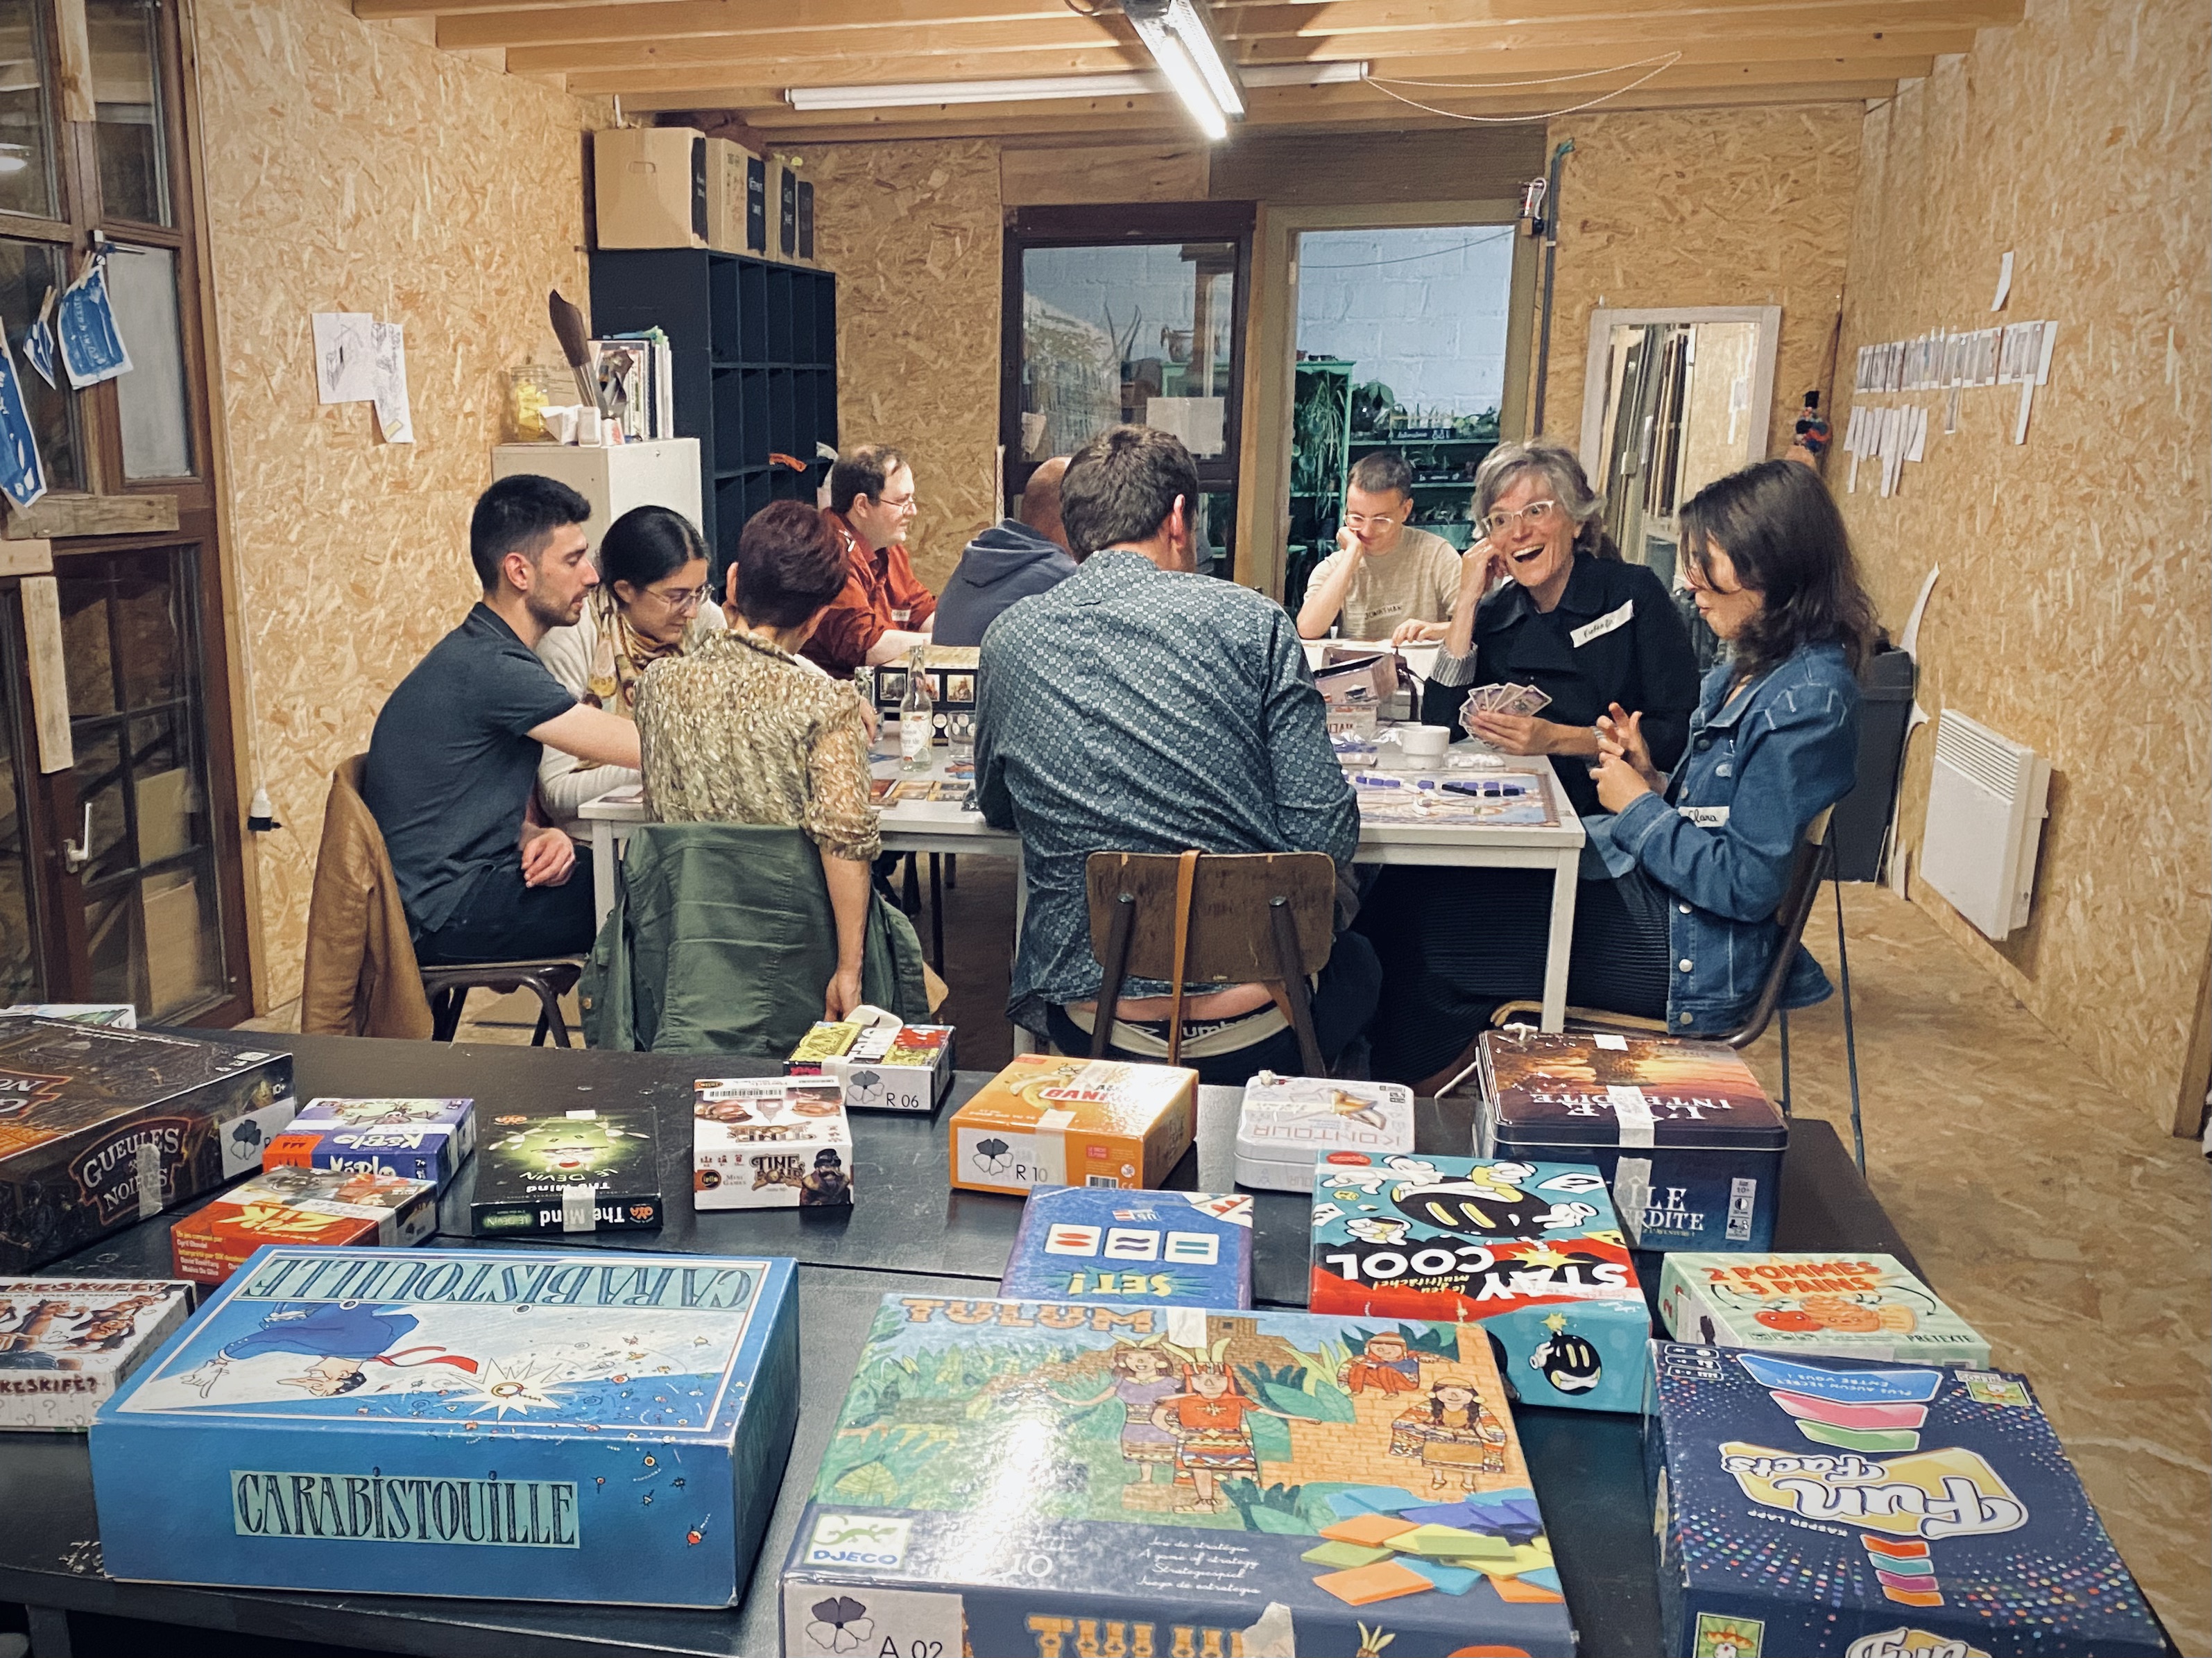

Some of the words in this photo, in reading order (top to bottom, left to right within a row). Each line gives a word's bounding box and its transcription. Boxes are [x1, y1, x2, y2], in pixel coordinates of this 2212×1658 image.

[1182, 1014, 1262, 1037] umb
[886, 1093, 895, 1107] R
[901, 1094, 919, 1108] 06
[1530, 1093, 1732, 1109] INTEDITE
[83, 1128, 180, 1188] GUEULES
[519, 1171, 586, 1182] DEVIN
[1016, 1164, 1026, 1180] R
[1034, 1167, 1049, 1183] 10
[540, 1209, 585, 1226] Mind
[593, 1207, 625, 1223] The
[1326, 1246, 1495, 1280] COOL
[1701, 1267, 1728, 1281] 2
[1731, 1261, 1883, 1281] POMMES
[246, 1258, 751, 1311] CARABISTOUILLE
[1068, 1271, 1173, 1296] SET!
[1475, 1263, 1629, 1302] STAY
[1743, 1281, 1769, 1295] 3
[1772, 1277, 1877, 1295] PAINS
[903, 1298, 1156, 1333] TULUM
[1724, 1455, 1885, 1482] Facts
[237, 1465, 576, 1545] CARABISTOUILLE
[1773, 1478, 2025, 1539] Fun
[814, 1549, 898, 1565] DJECO
[878, 1635, 900, 1658] A
[911, 1639, 943, 1658] 02
